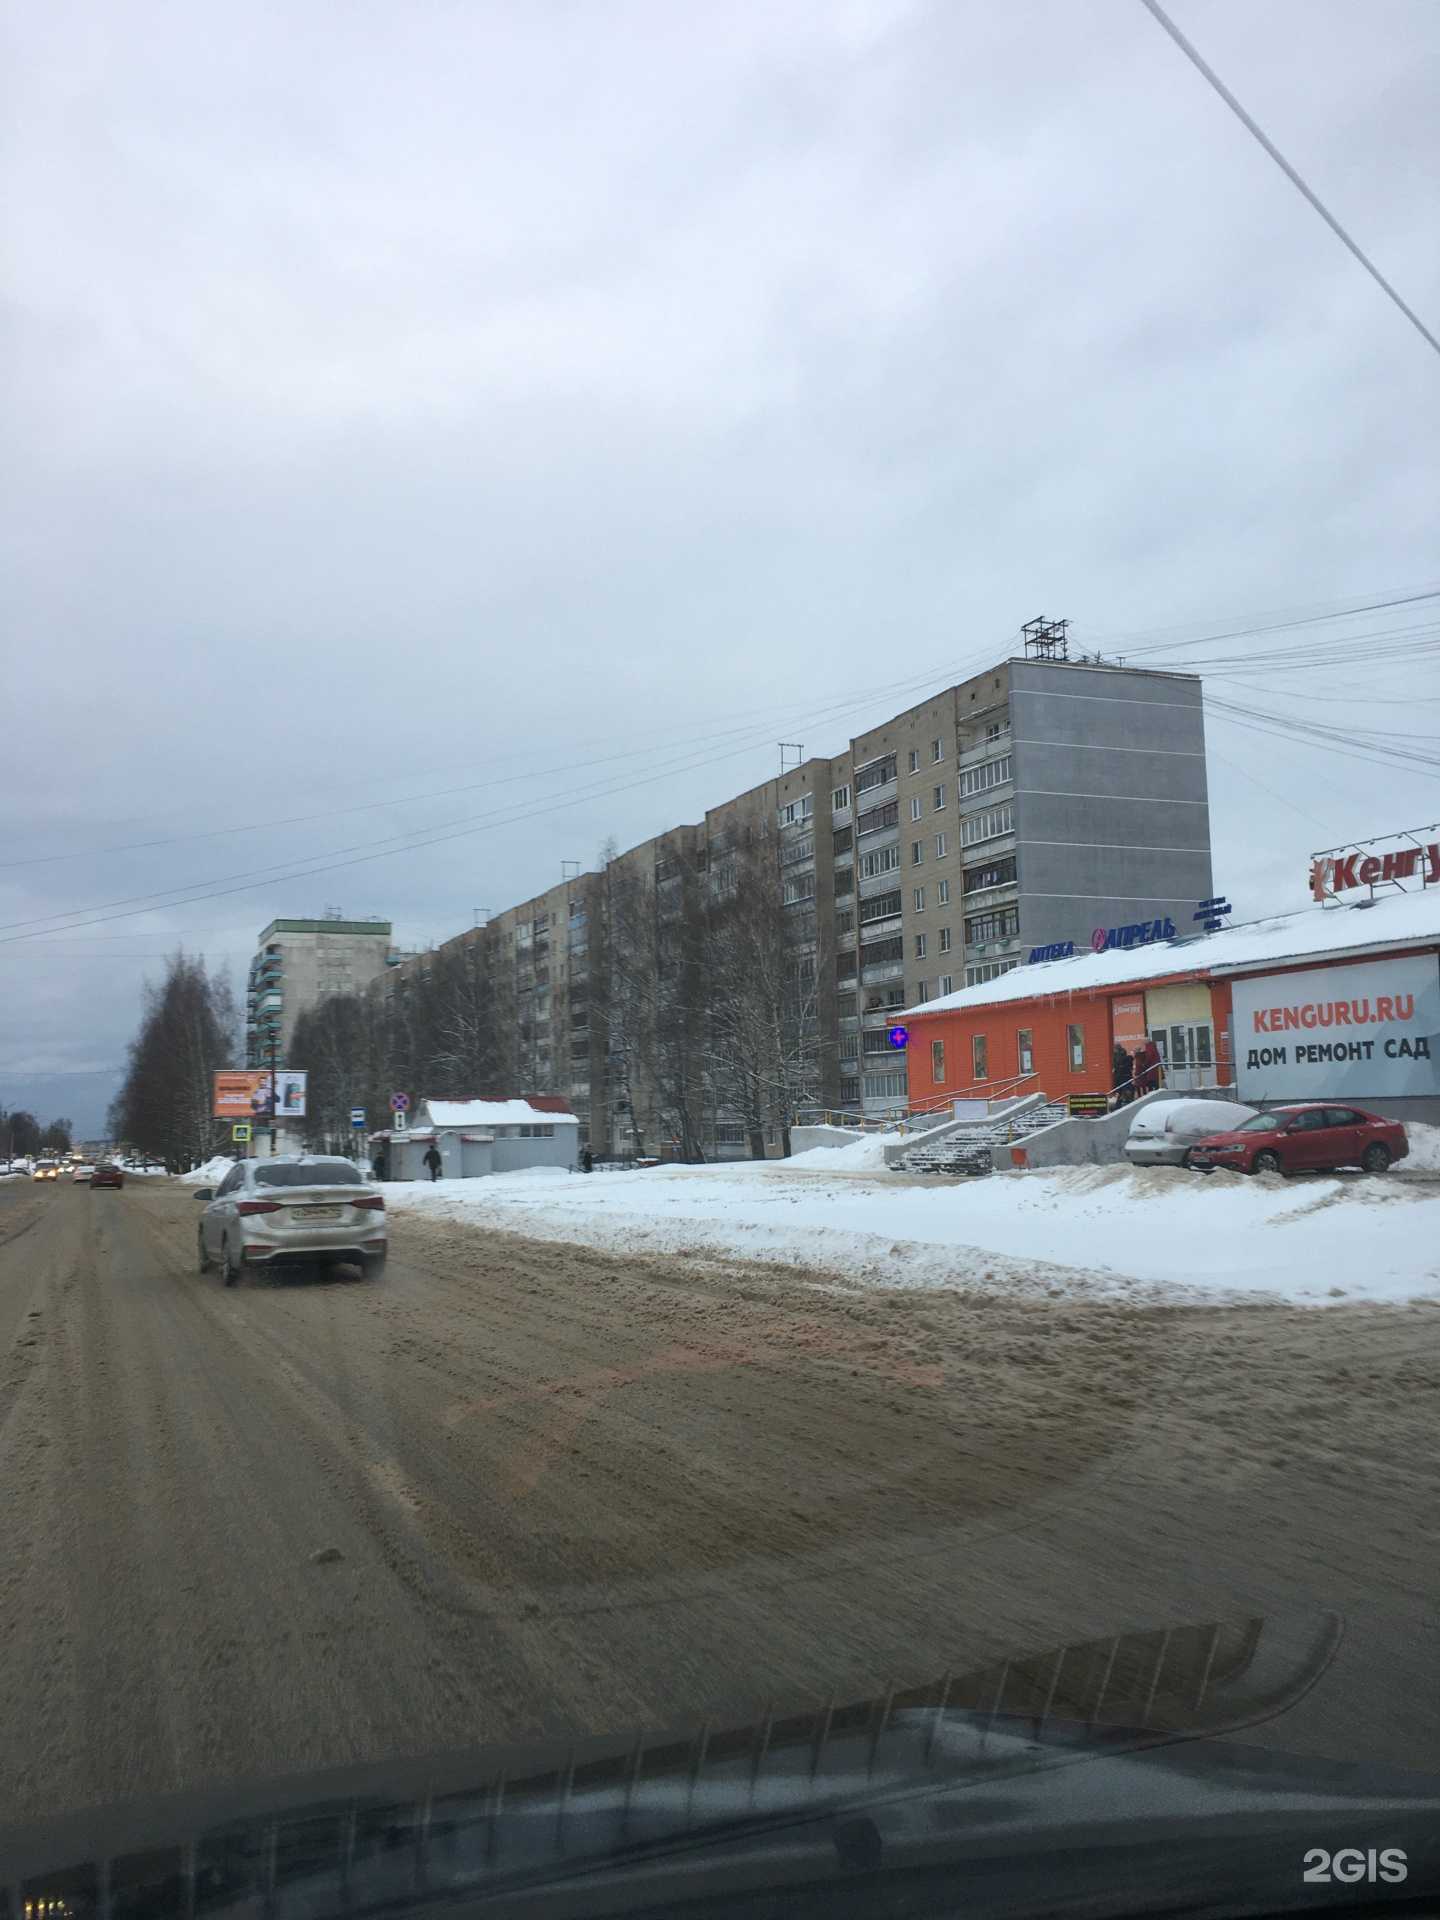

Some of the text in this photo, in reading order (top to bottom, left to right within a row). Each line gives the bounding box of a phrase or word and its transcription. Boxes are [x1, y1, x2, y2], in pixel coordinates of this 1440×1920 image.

[1028, 941, 1074, 963] АПТЕКА
[1104, 917, 1176, 949] АПРЕЛЬ
[1253, 994, 1414, 1033] KENGURU.RU
[1247, 1037, 1431, 1069] ДОМ РЕМОНТ САД
